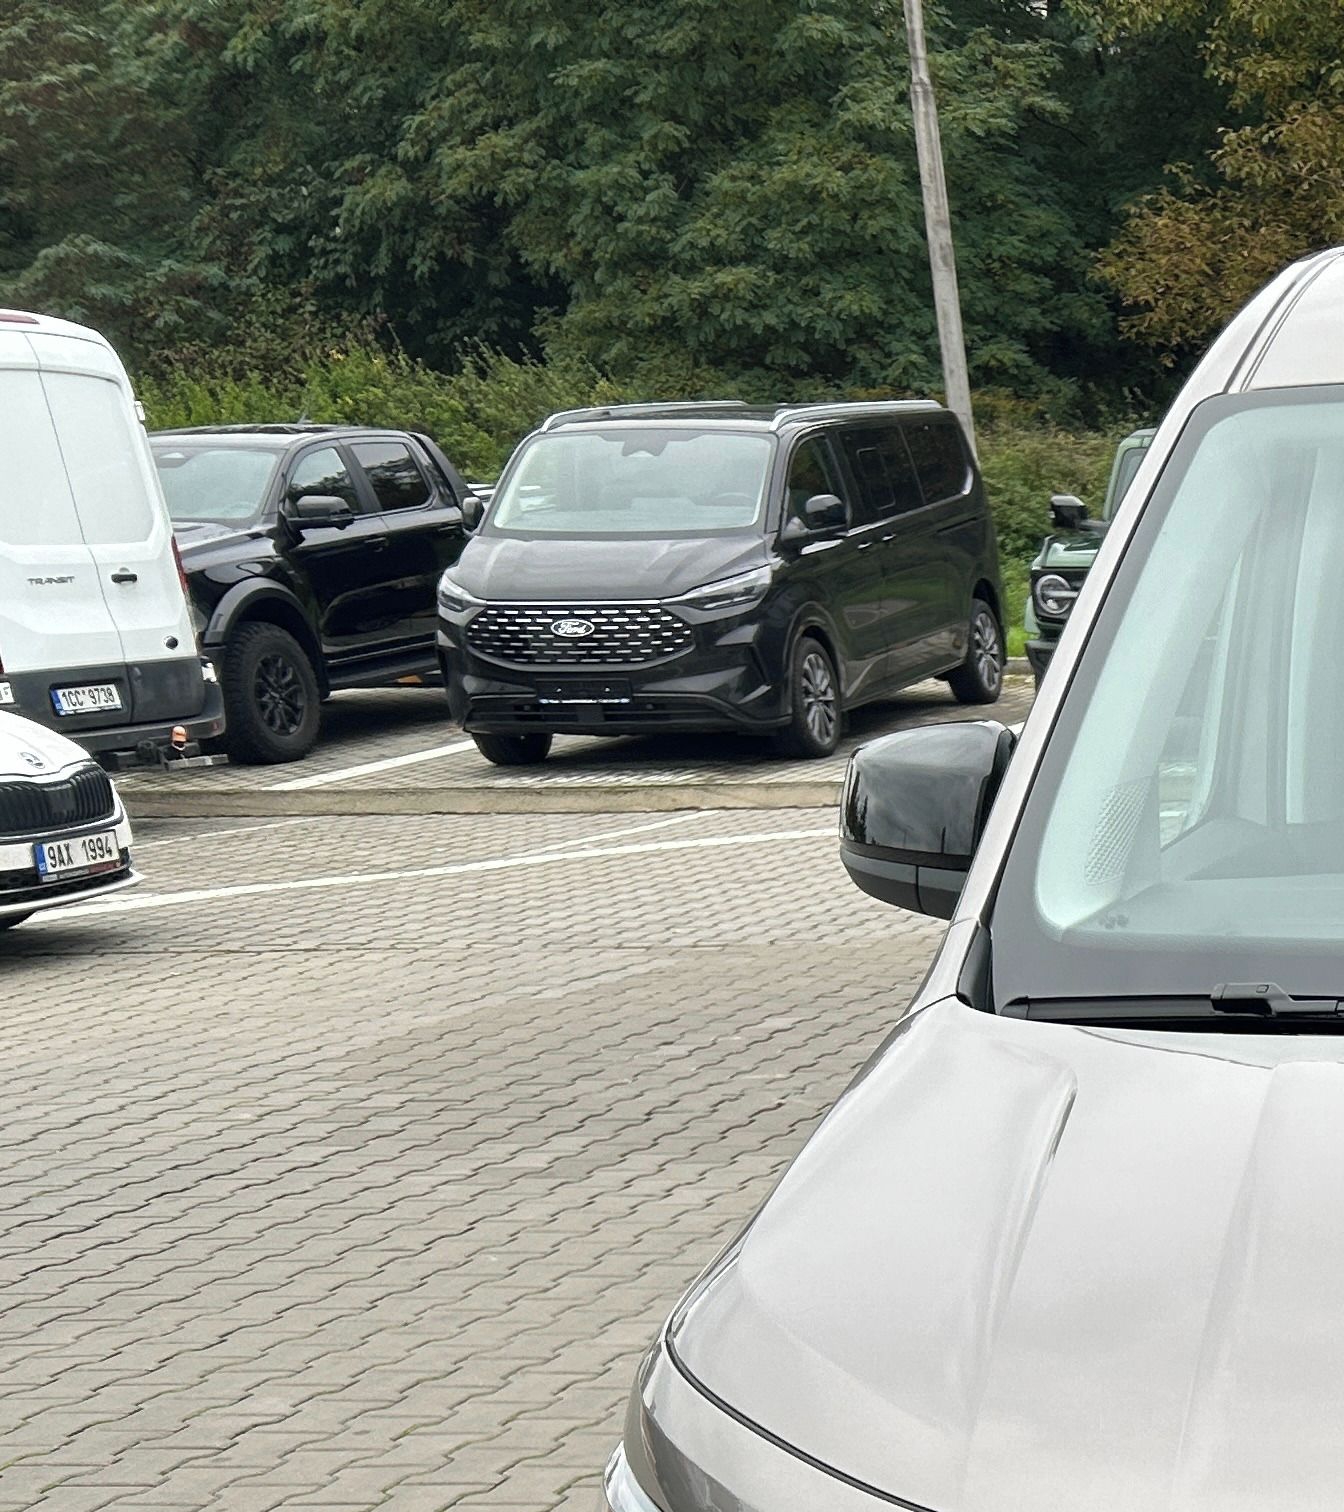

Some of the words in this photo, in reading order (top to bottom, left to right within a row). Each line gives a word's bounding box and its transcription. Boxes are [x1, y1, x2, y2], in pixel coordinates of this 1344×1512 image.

[61, 690, 84, 708] 1CC
[47, 843, 73, 868] 9AX
[81, 835, 112, 861] 1994
